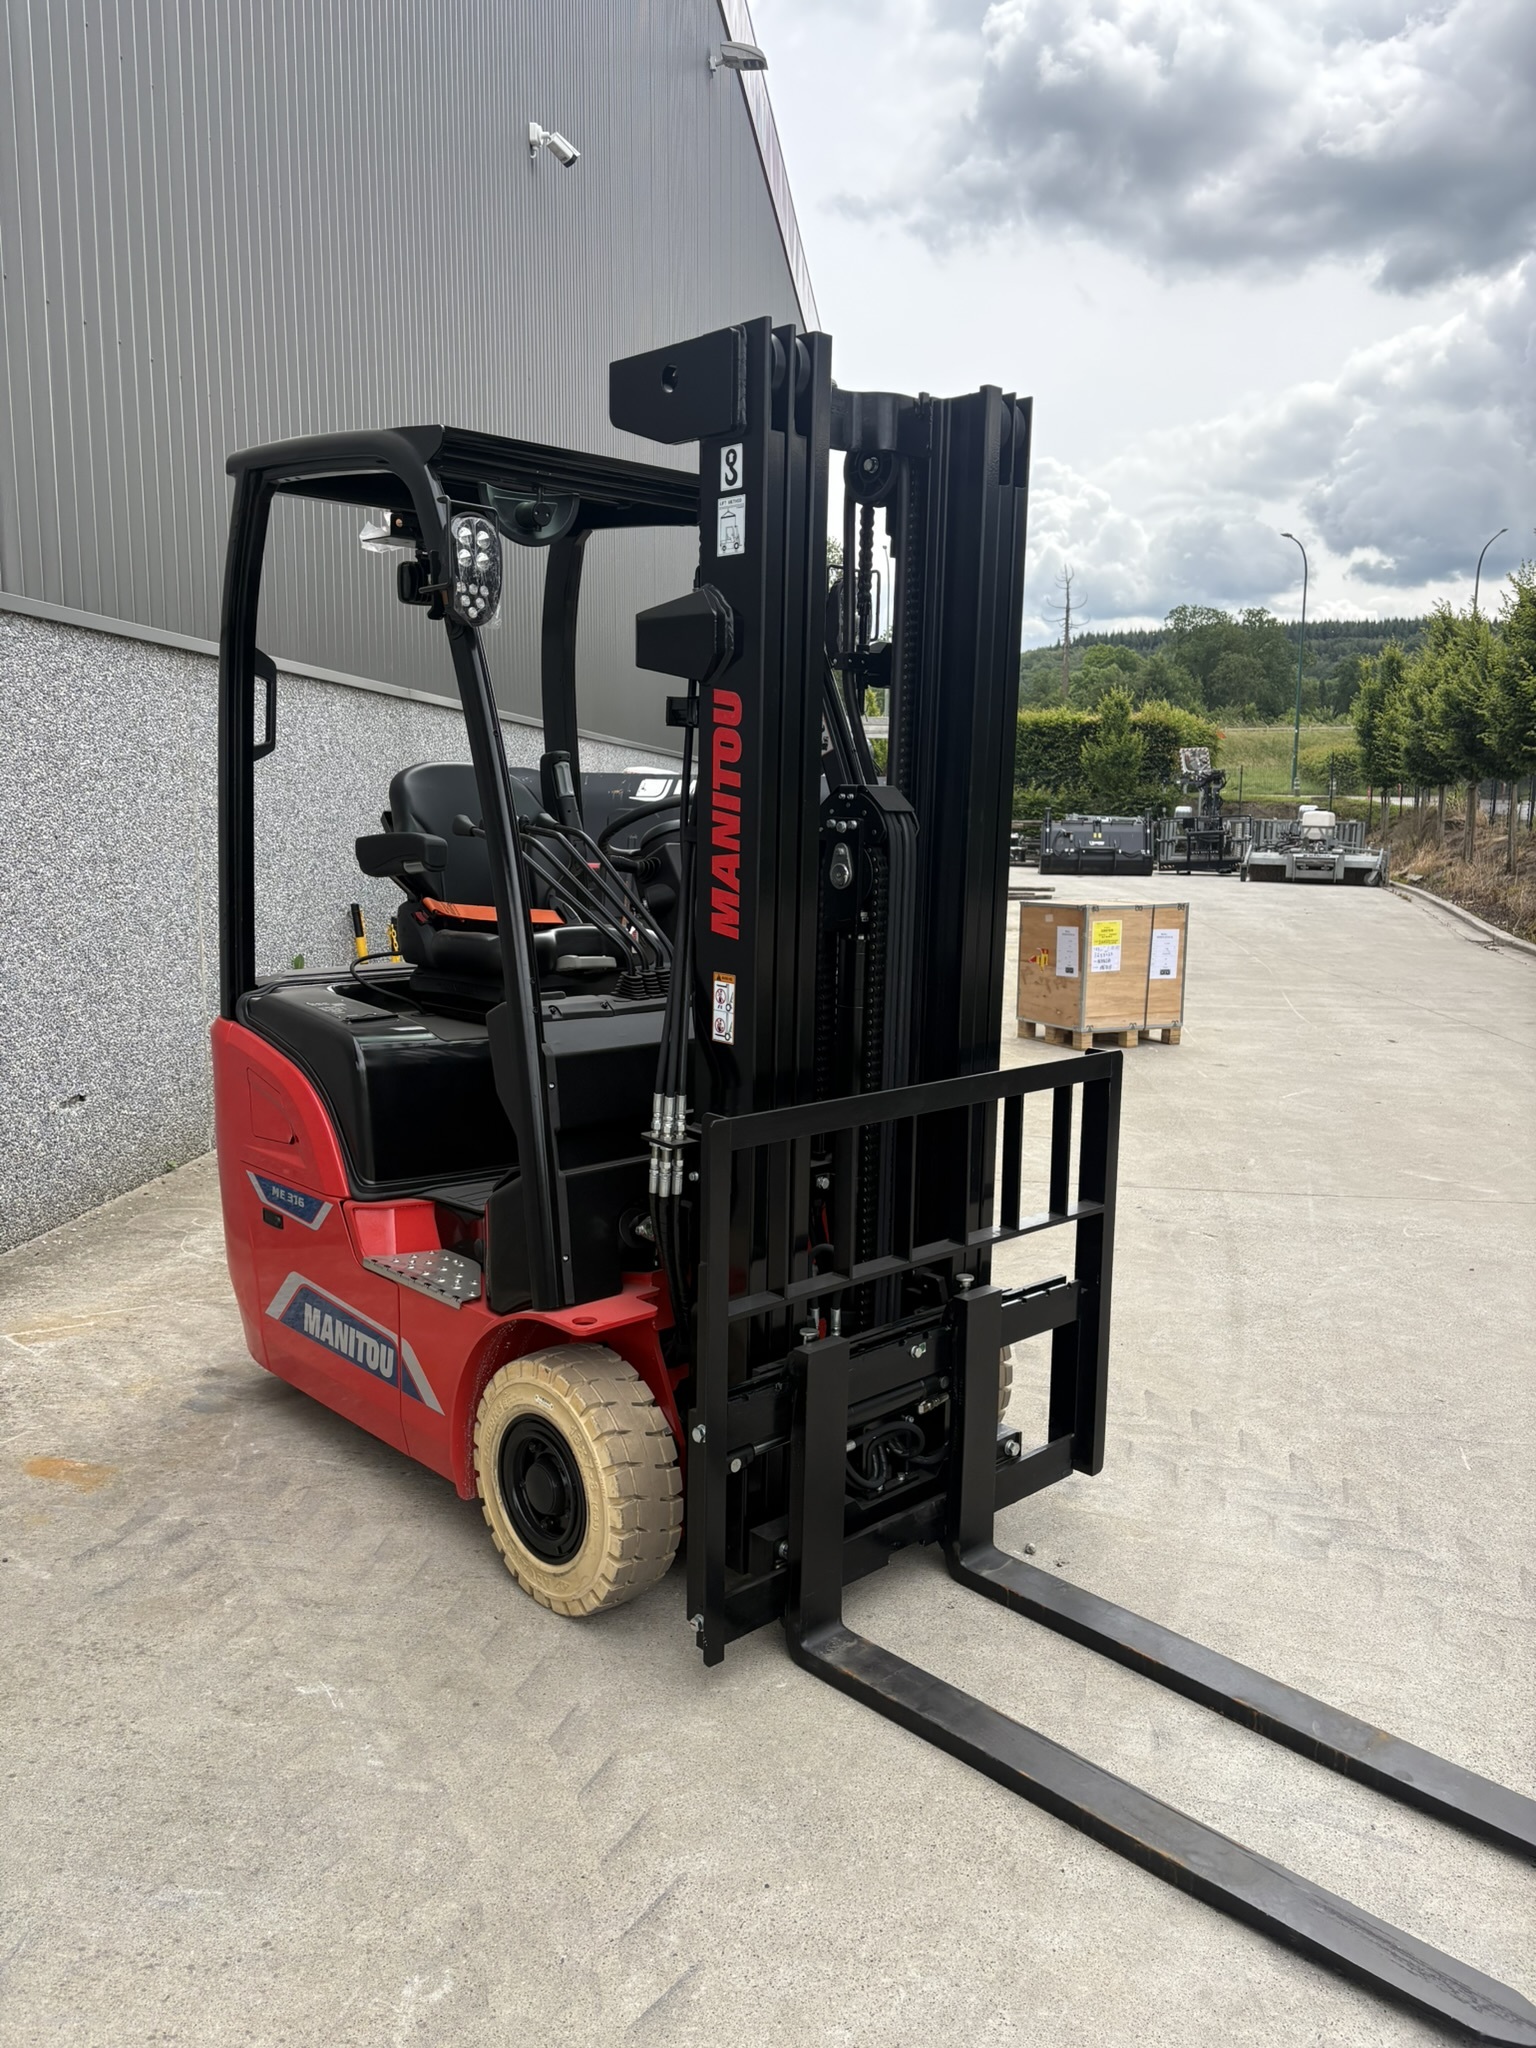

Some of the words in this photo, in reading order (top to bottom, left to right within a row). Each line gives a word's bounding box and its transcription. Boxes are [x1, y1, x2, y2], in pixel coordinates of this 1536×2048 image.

[711, 688, 743, 940] MANITOU
[271, 1185, 286, 1202] ME
[286, 1193, 305, 1209] 316
[304, 1303, 393, 1378] MANITOU
